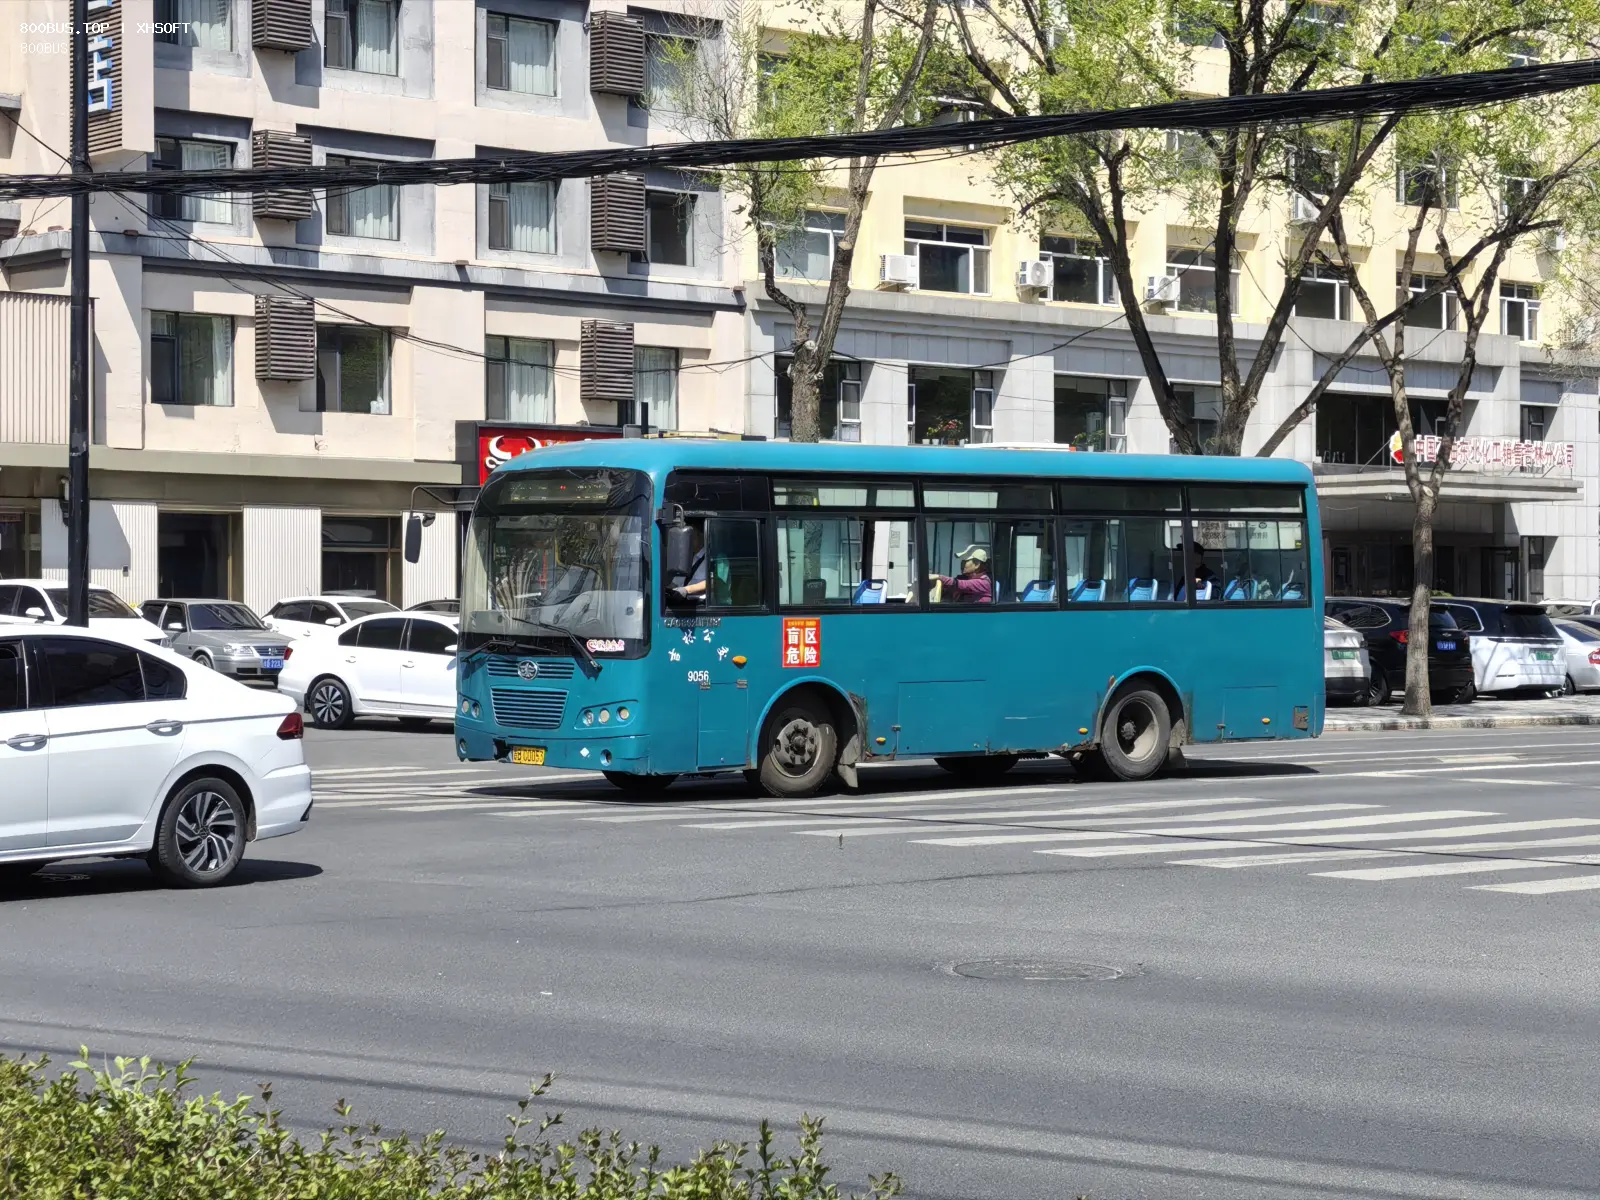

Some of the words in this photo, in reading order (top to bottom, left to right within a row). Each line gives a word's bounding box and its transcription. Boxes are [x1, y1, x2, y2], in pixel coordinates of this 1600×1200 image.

[787, 627, 818, 644] 盲区
[786, 646, 818, 664] 危险
[688, 671, 709, 682] 9056
